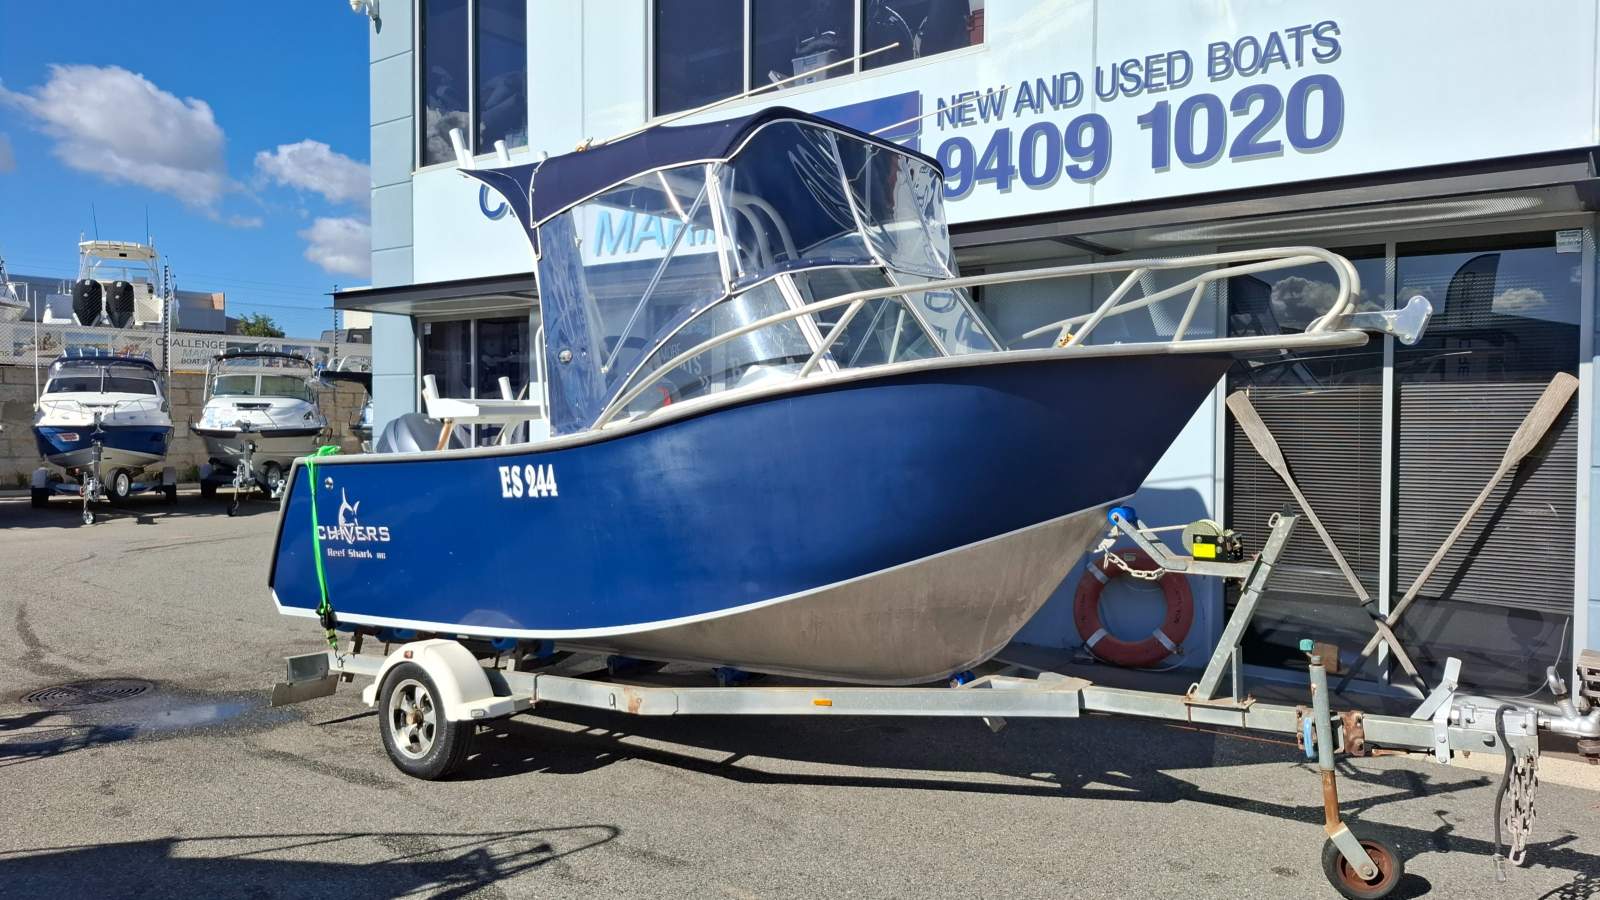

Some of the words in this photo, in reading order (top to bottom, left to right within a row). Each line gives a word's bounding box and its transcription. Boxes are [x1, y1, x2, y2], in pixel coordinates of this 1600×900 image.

[936, 88, 1007, 129] NEW
[1013, 72, 1083, 114] AND
[1095, 50, 1193, 101] USED
[1207, 20, 1342, 82] BOATS
[936, 113, 1112, 201] 9409
[1137, 74, 1345, 173] 1020
[498, 464, 524, 499] ES
[524, 463, 559, 498] 244
[327, 547, 346, 557] Reef
[347, 548, 373, 559] Shark
